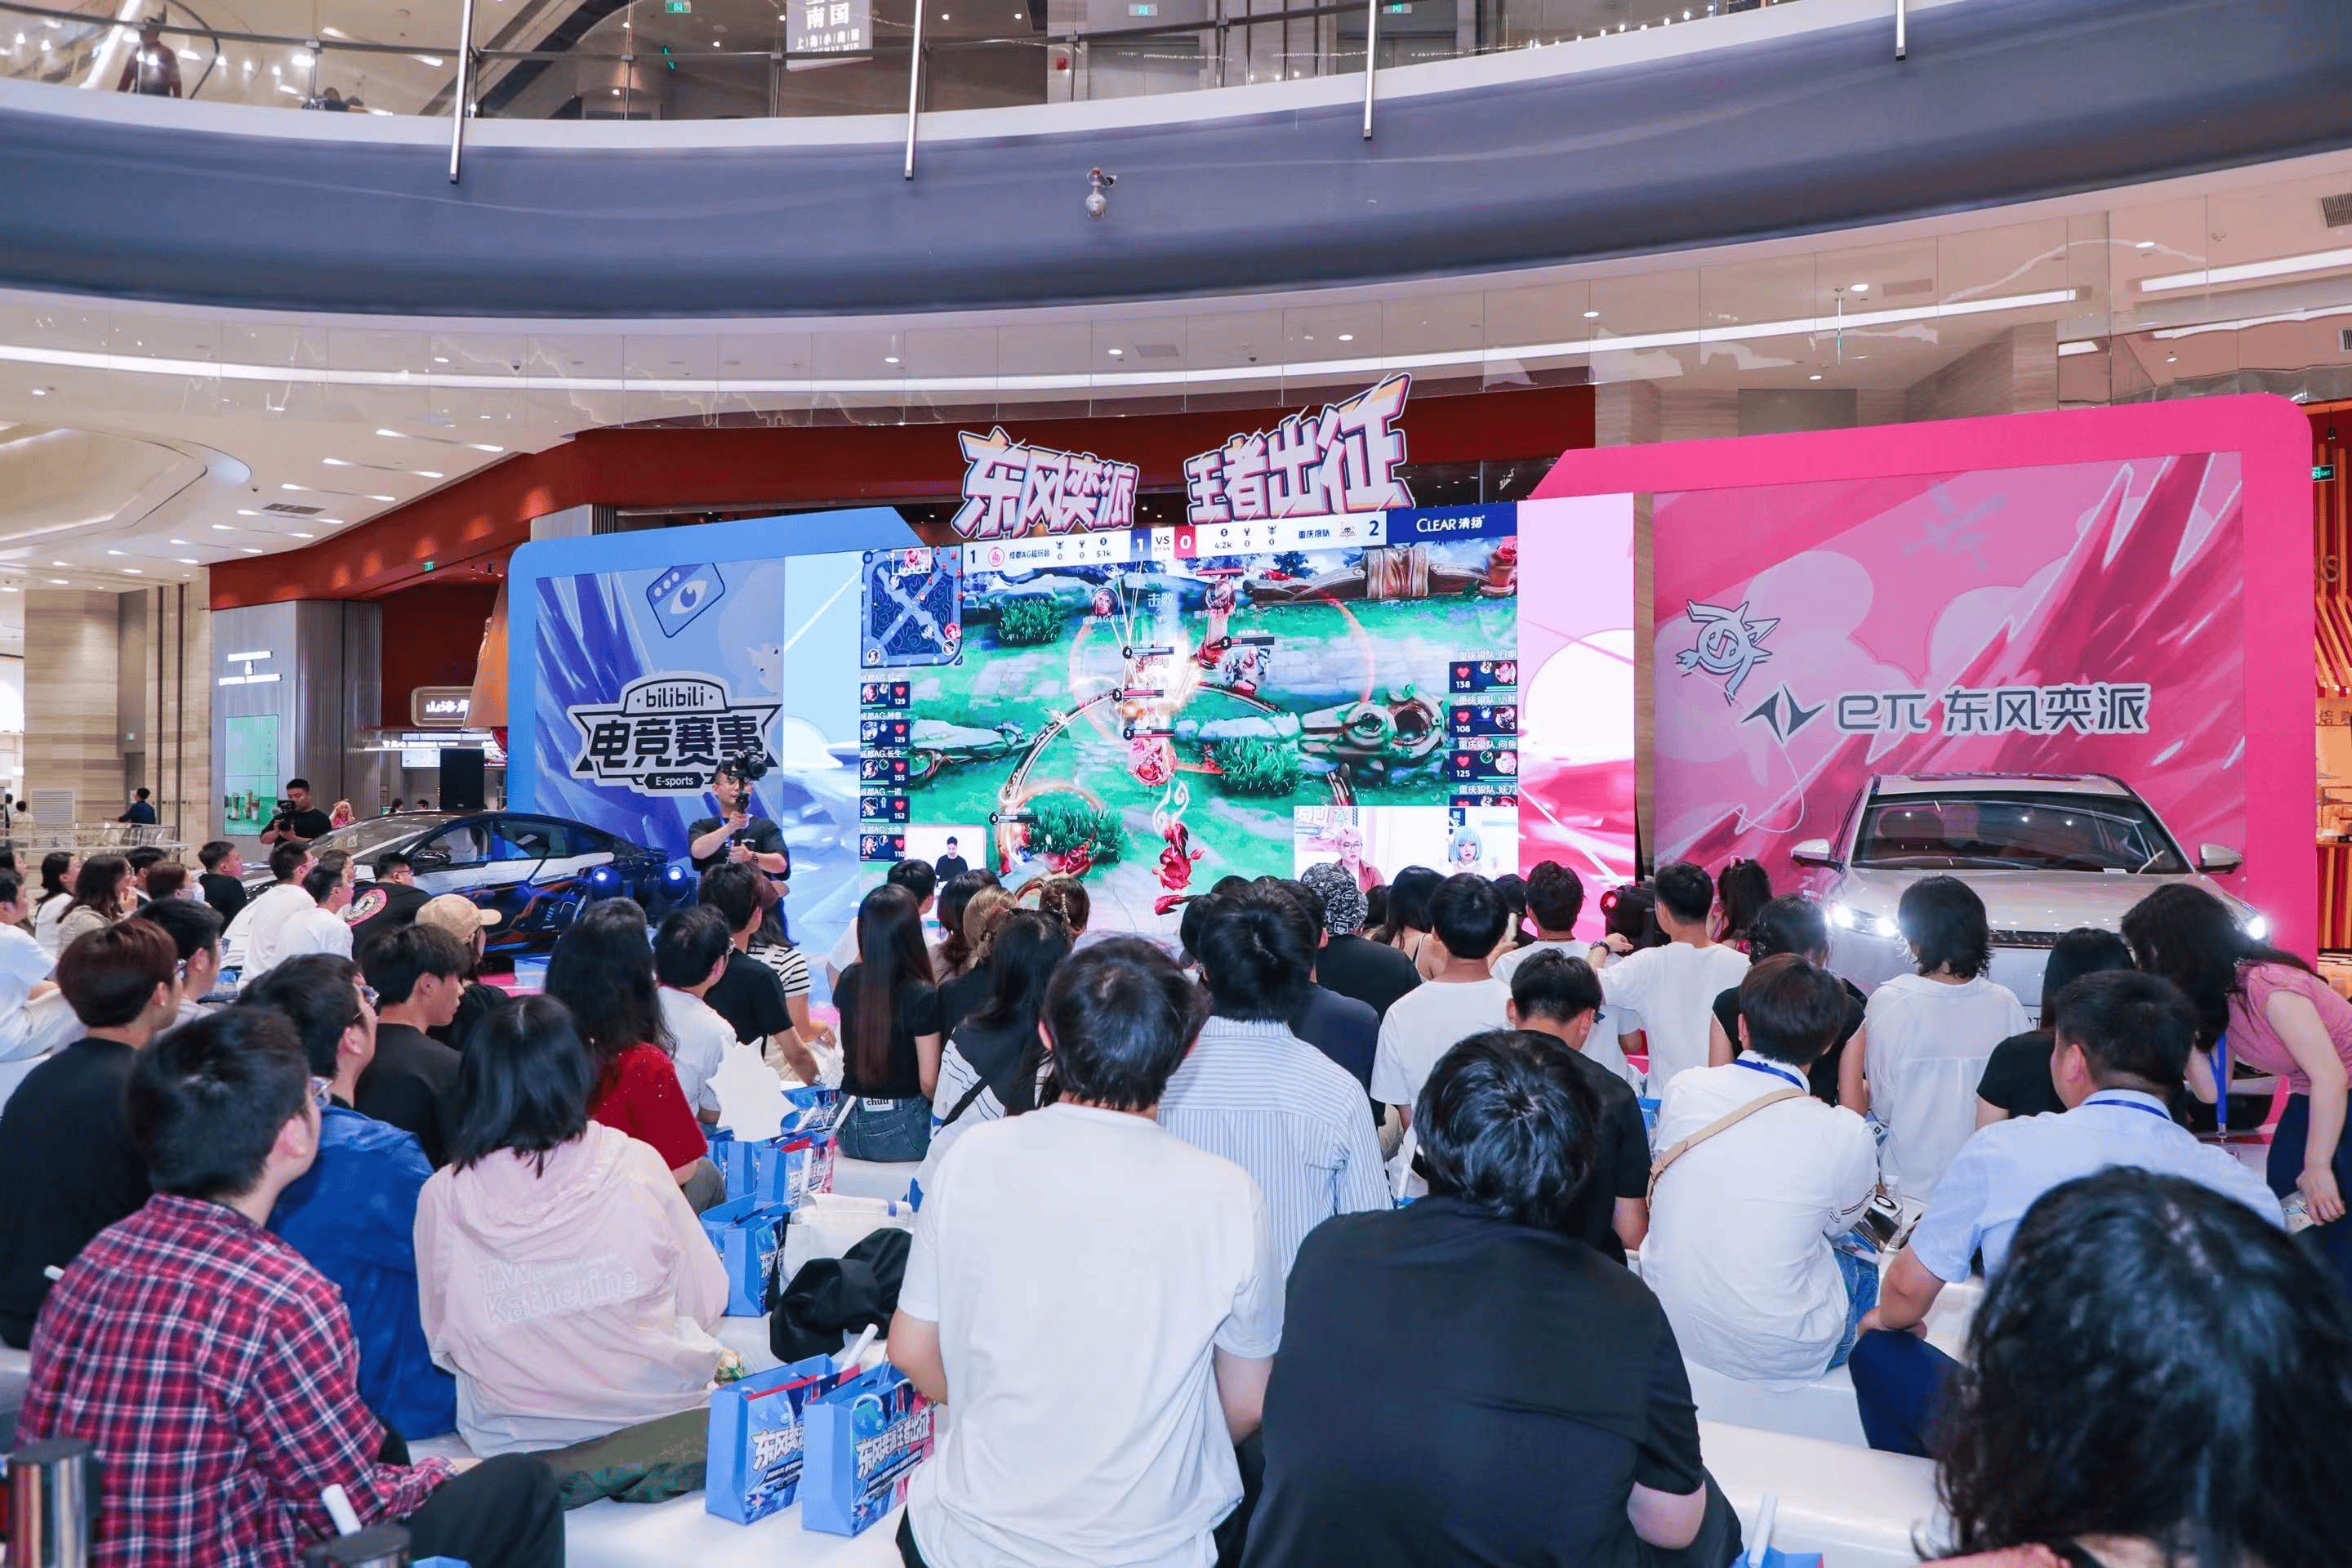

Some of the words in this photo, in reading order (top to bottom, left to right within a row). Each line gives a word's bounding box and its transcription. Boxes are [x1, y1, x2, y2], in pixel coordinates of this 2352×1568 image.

[951, 426, 1139, 539] 东风奕派
[1184, 373, 1416, 525] 王者出征
[1369, 520, 1379, 537] 2
[1416, 518, 1457, 533] CLEAR
[1458, 516, 1483, 530] 清扬
[1136, 537, 1144, 553] 1
[1156, 535, 1170, 546] VS
[1180, 535, 1192, 550] 0
[970, 550, 976, 564] 1
[1455, 680, 1471, 689] 138
[646, 686, 704, 709] bilibili
[1944, 686, 2150, 732] 东风奕派
[1455, 725, 1471, 733] 108
[590, 715, 764, 768] 电竞赛事
[1456, 769, 1471, 777] 125
[655, 775, 694, 787] E-sports
[866, 1098, 889, 1106] chuu
